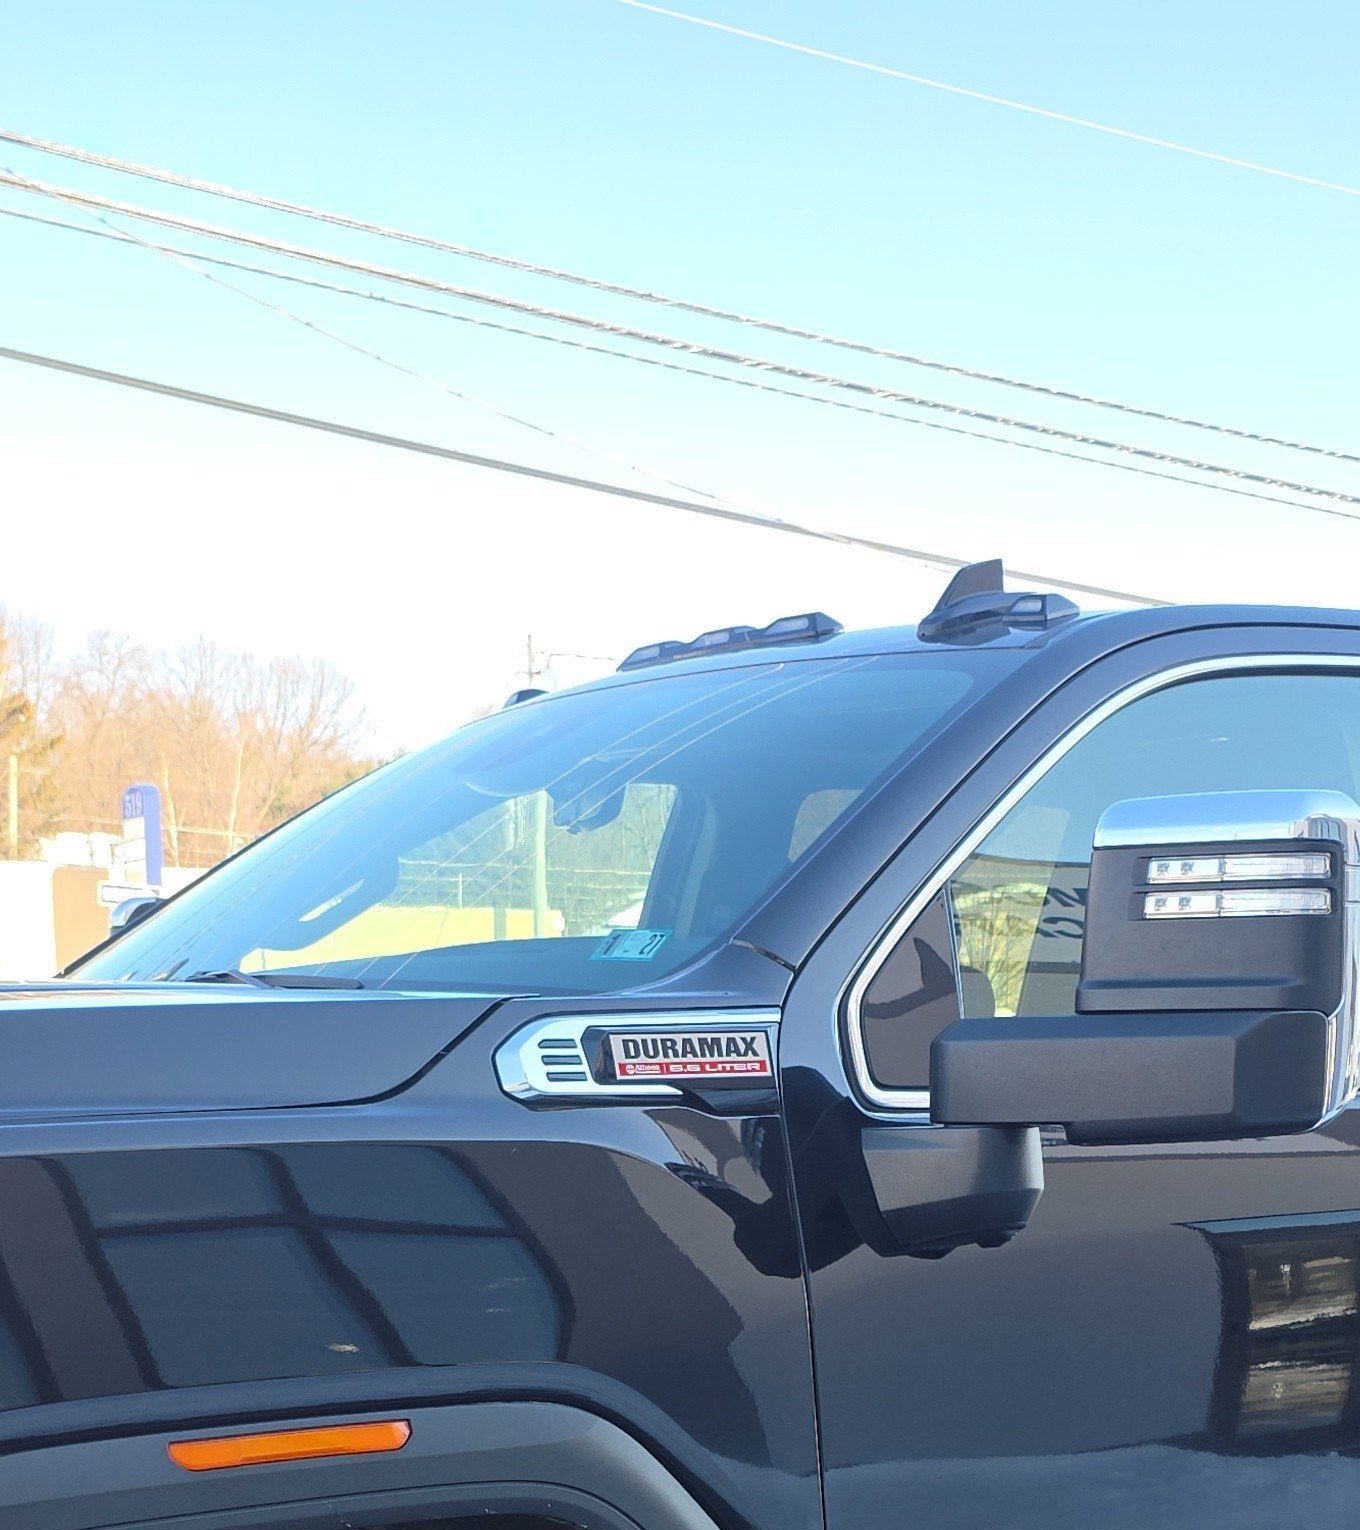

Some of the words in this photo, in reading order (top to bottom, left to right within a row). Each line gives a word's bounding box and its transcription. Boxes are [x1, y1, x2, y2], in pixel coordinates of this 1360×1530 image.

[124, 791, 142, 817] 519
[639, 933, 666, 955] 27
[620, 1036, 760, 1060] DURAMAX
[669, 1064, 701, 1073] 6.6
[704, 1062, 761, 1073] LITER
